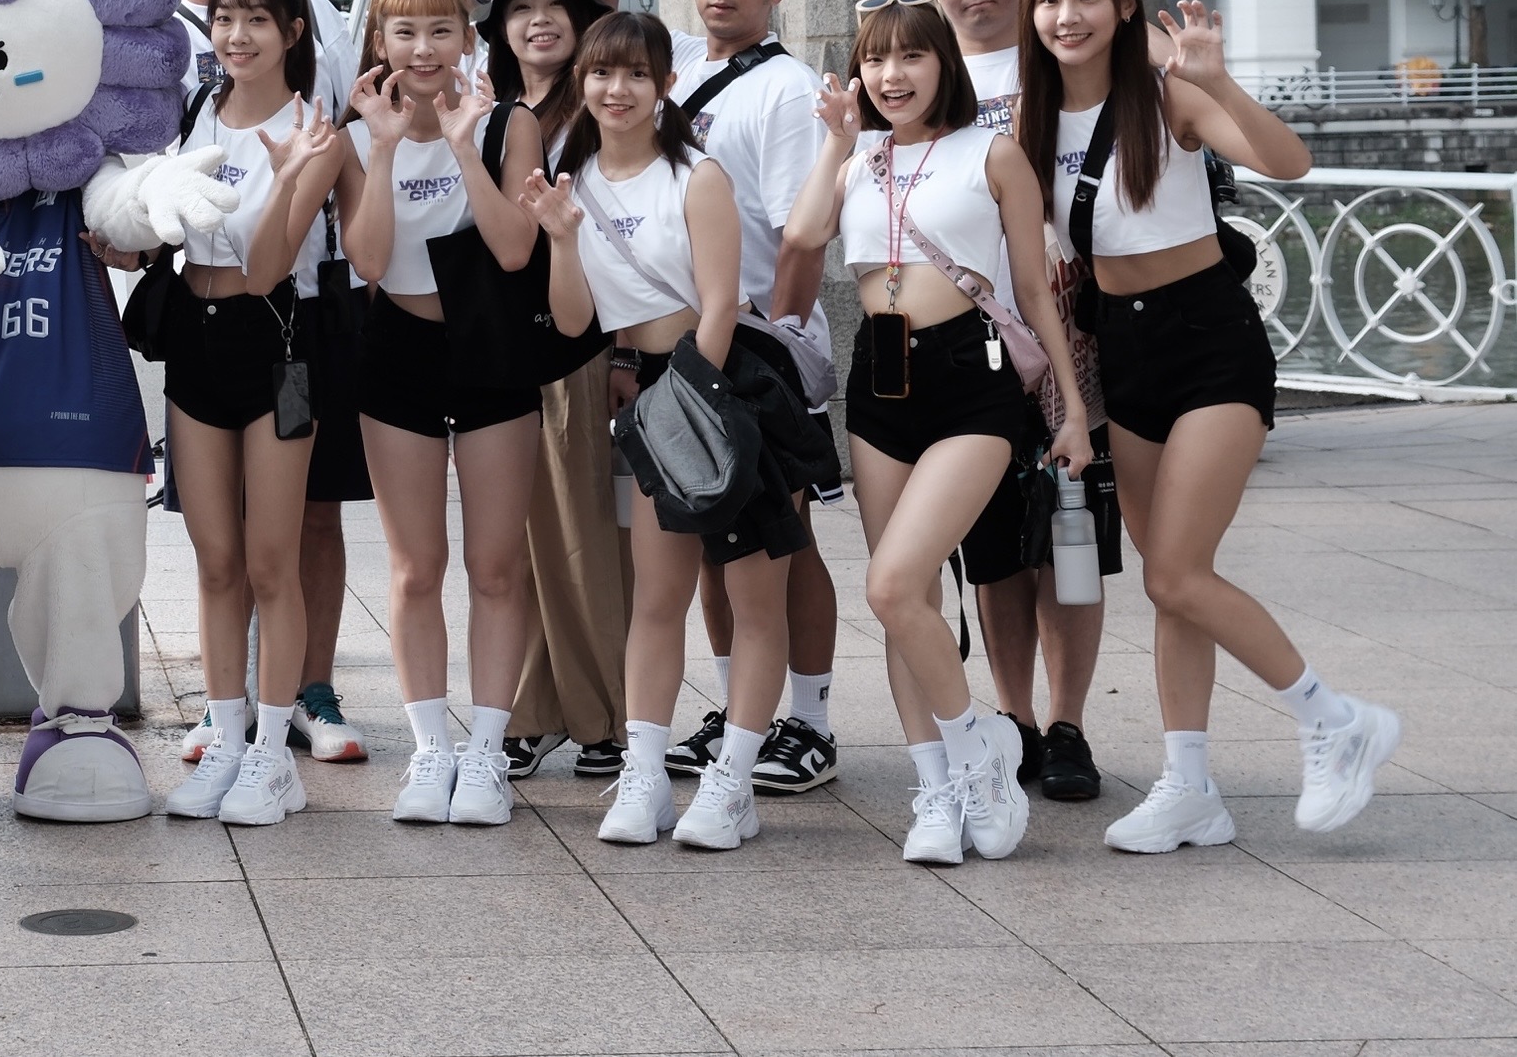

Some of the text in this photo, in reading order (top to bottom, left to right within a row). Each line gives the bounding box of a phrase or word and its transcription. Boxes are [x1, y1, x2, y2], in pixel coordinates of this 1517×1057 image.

[399, 173, 462, 191] WINDY
[409, 187, 452, 202] CITY
[1, 297, 49, 340] 66
[991, 757, 1007, 804] FILA
[726, 794, 752, 821] FILA
